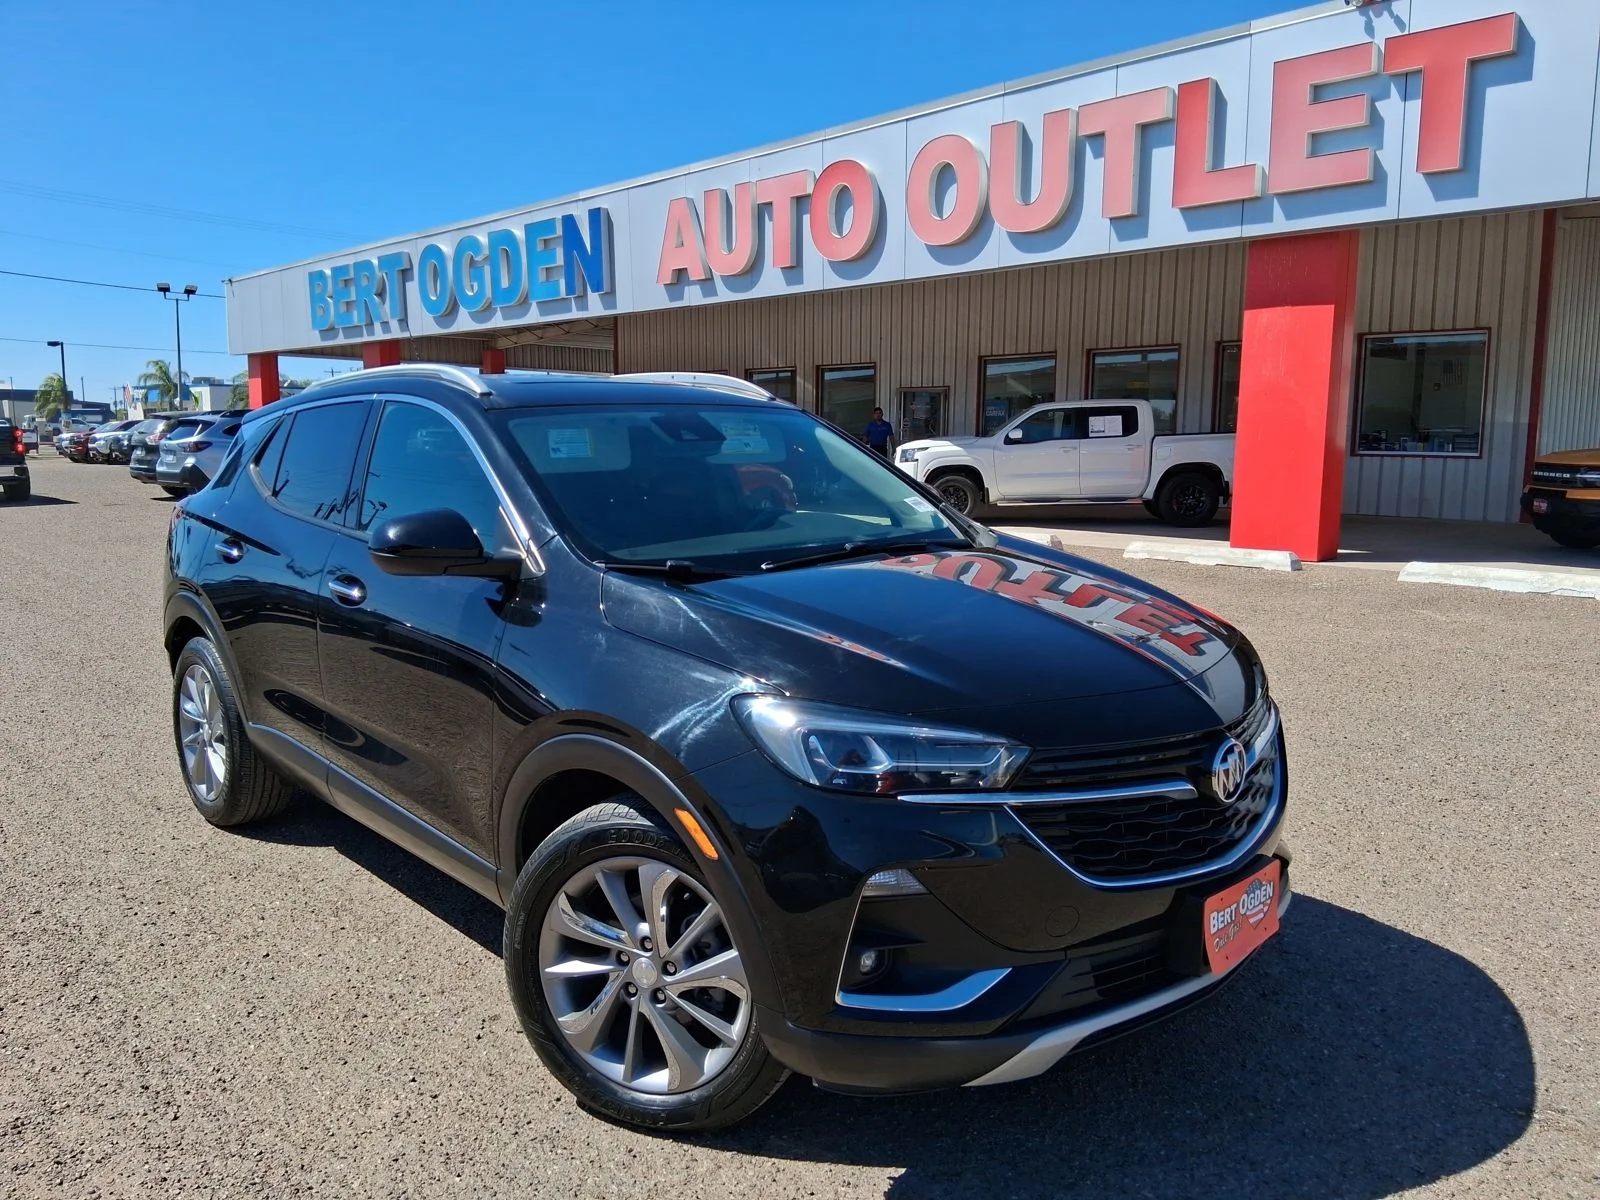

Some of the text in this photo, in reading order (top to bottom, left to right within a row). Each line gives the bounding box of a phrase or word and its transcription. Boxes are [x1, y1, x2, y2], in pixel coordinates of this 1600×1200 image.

[656, 12, 1520, 285] AUTO OUTLET
[308, 207, 612, 321] BERT OGDEN
[1210, 881, 1274, 935] BERT OGDEN
